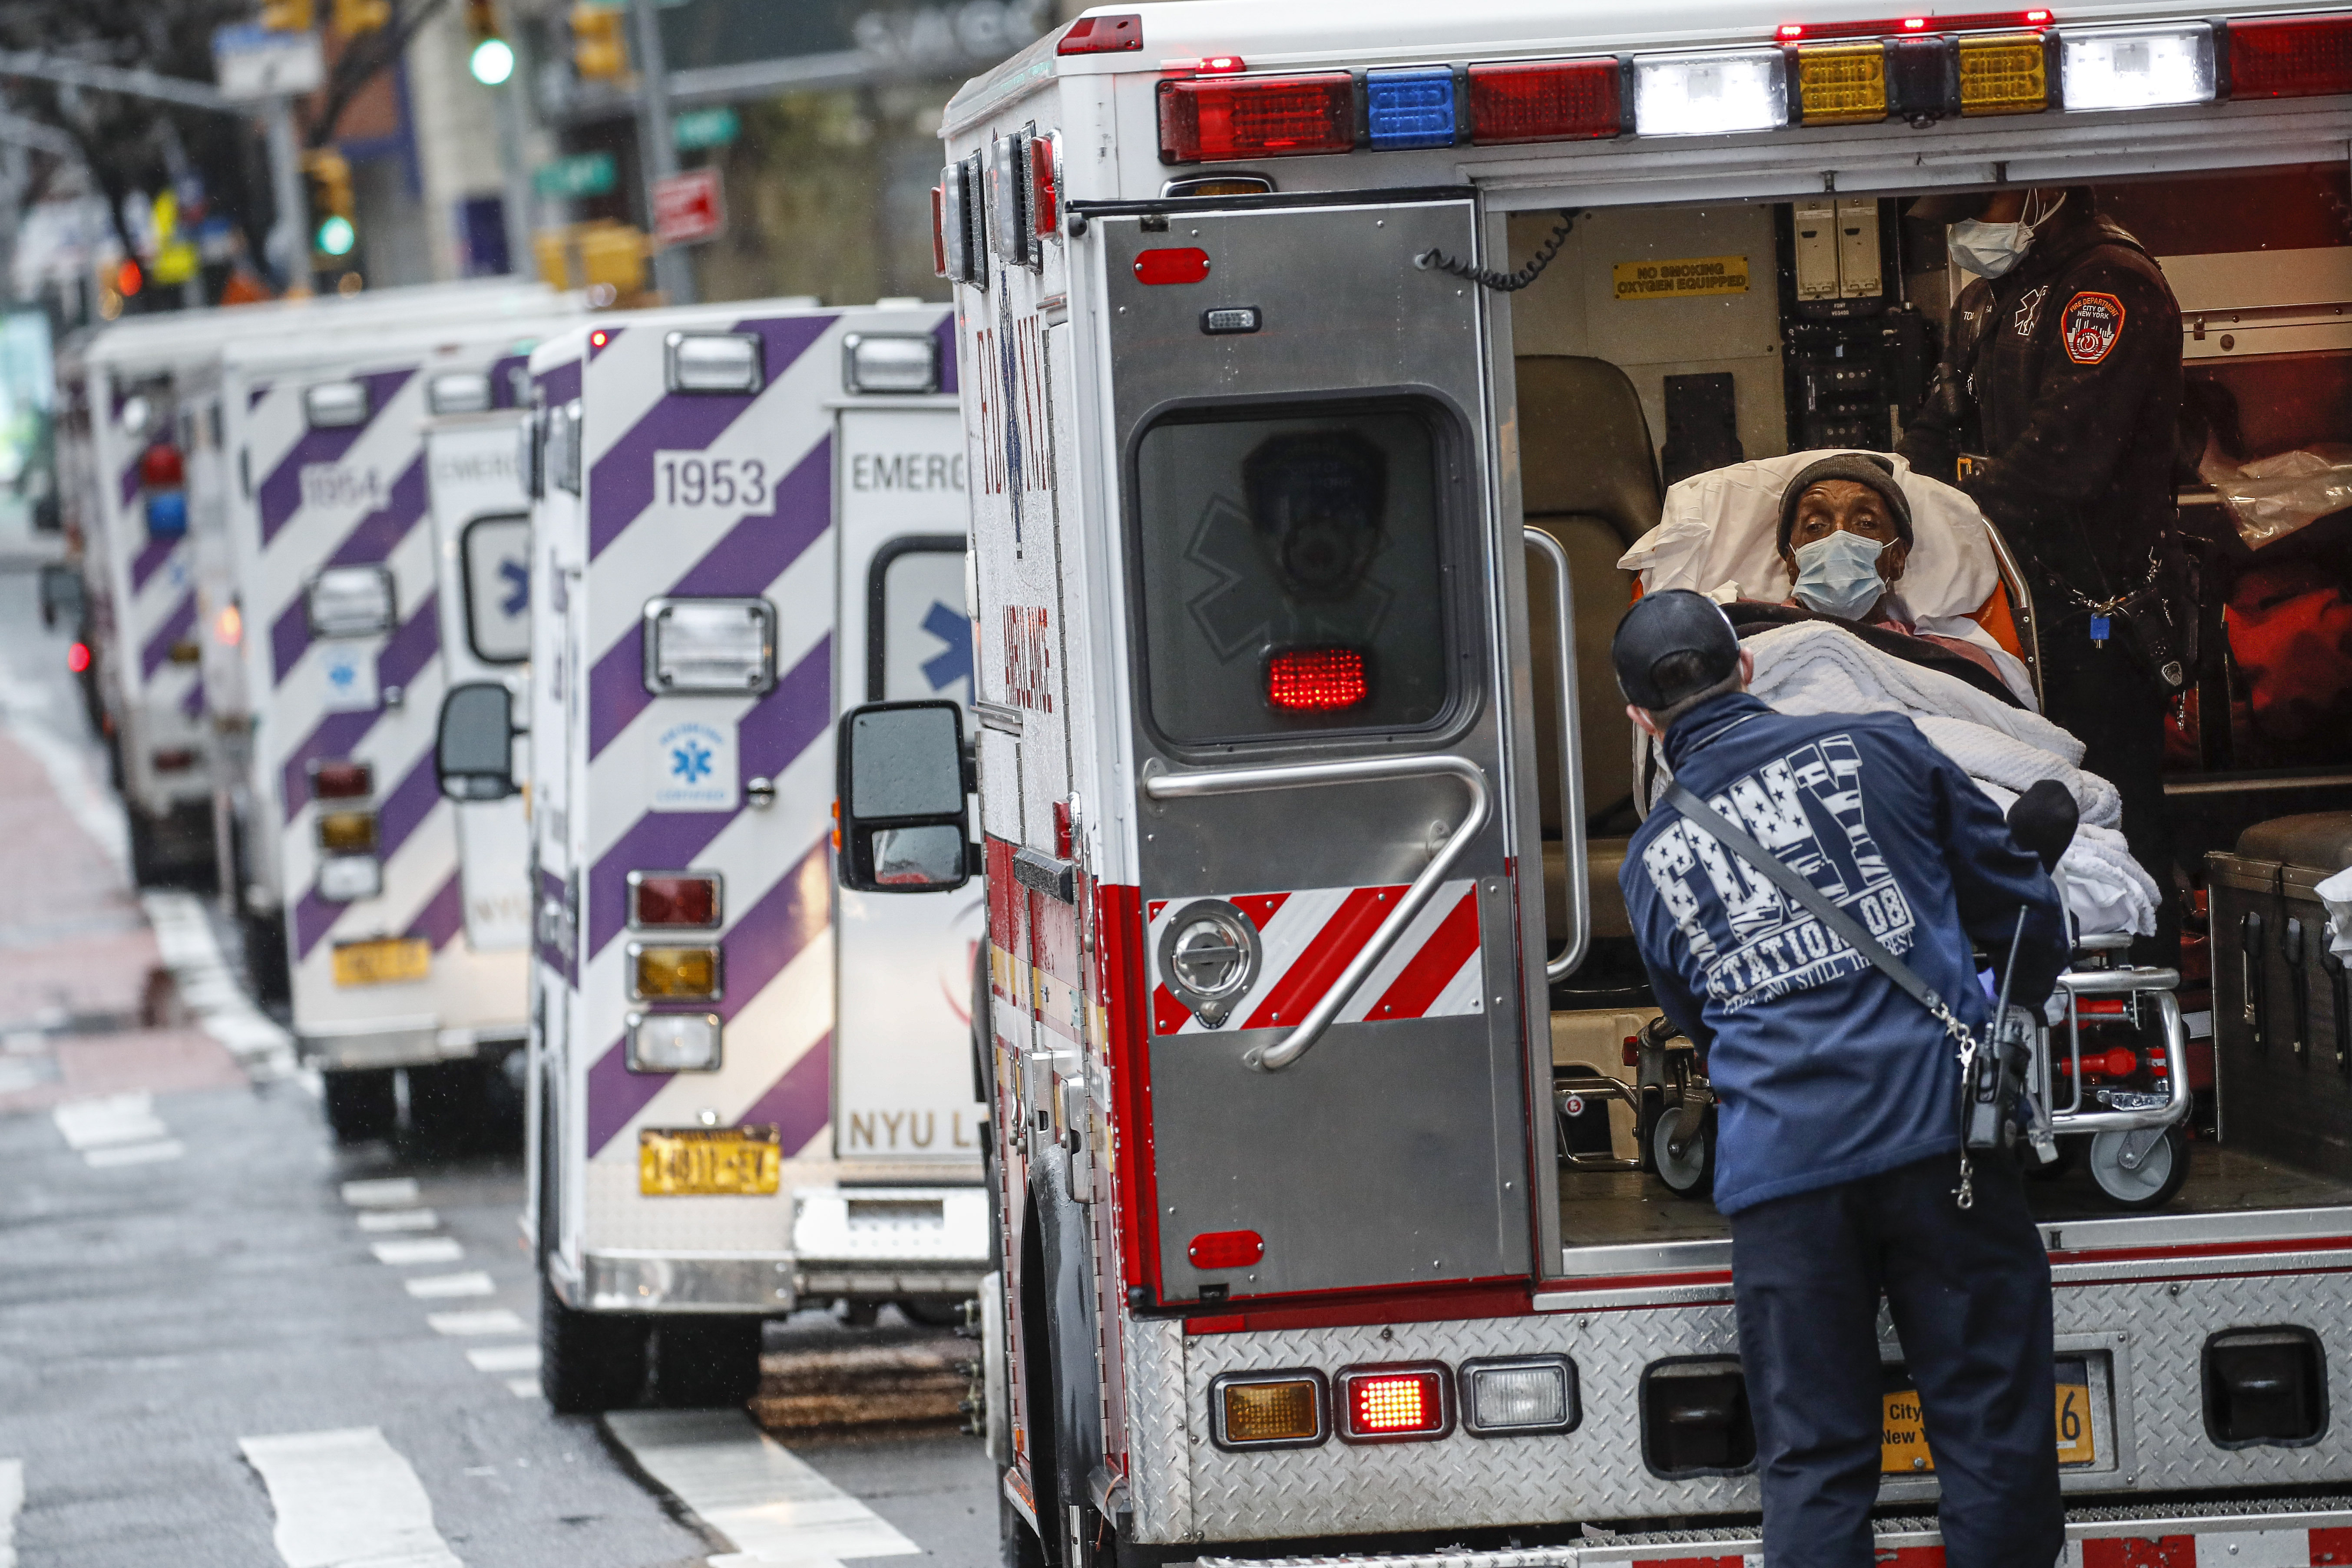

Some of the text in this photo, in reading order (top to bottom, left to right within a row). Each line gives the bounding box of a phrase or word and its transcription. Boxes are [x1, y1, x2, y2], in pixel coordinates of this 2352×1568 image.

[1617, 275, 1746, 294] OXYGEN EQUIPPED
[1637, 263, 1725, 279] NO SMOKING
[2070, 297, 2119, 317] FIRE DEPARTMENT
[662, 459, 766, 507] 1953
[1002, 604, 1052, 714] AMBULANCE
[1642, 733, 1896, 973] FDNY
[1859, 887, 1907, 936] 08
[1795, 958, 1845, 990] STILL
[850, 1110, 935, 1148] NYU
[1890, 1404, 1920, 1422] City
[1883, 1429, 1915, 1445] New
